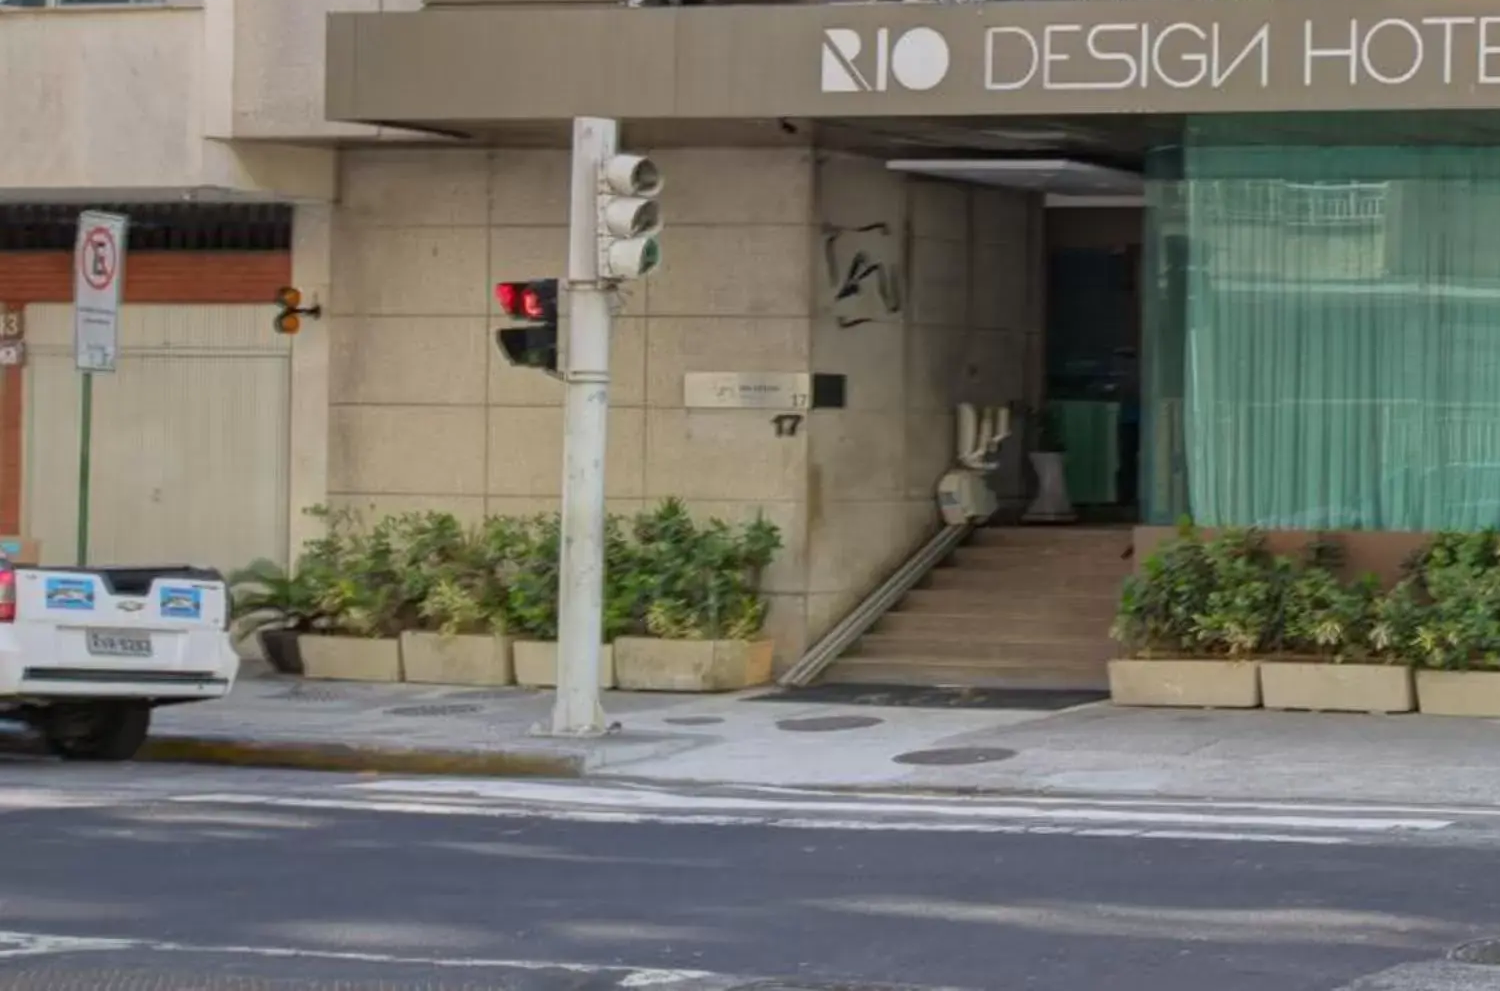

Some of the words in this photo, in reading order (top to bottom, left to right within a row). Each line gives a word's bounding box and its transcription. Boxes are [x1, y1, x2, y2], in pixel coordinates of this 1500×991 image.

[822, 27, 949, 92] RIO
[985, 22, 1269, 90] DESIGN
[792, 393, 807, 407] 17
[772, 414, 803, 437] 17
